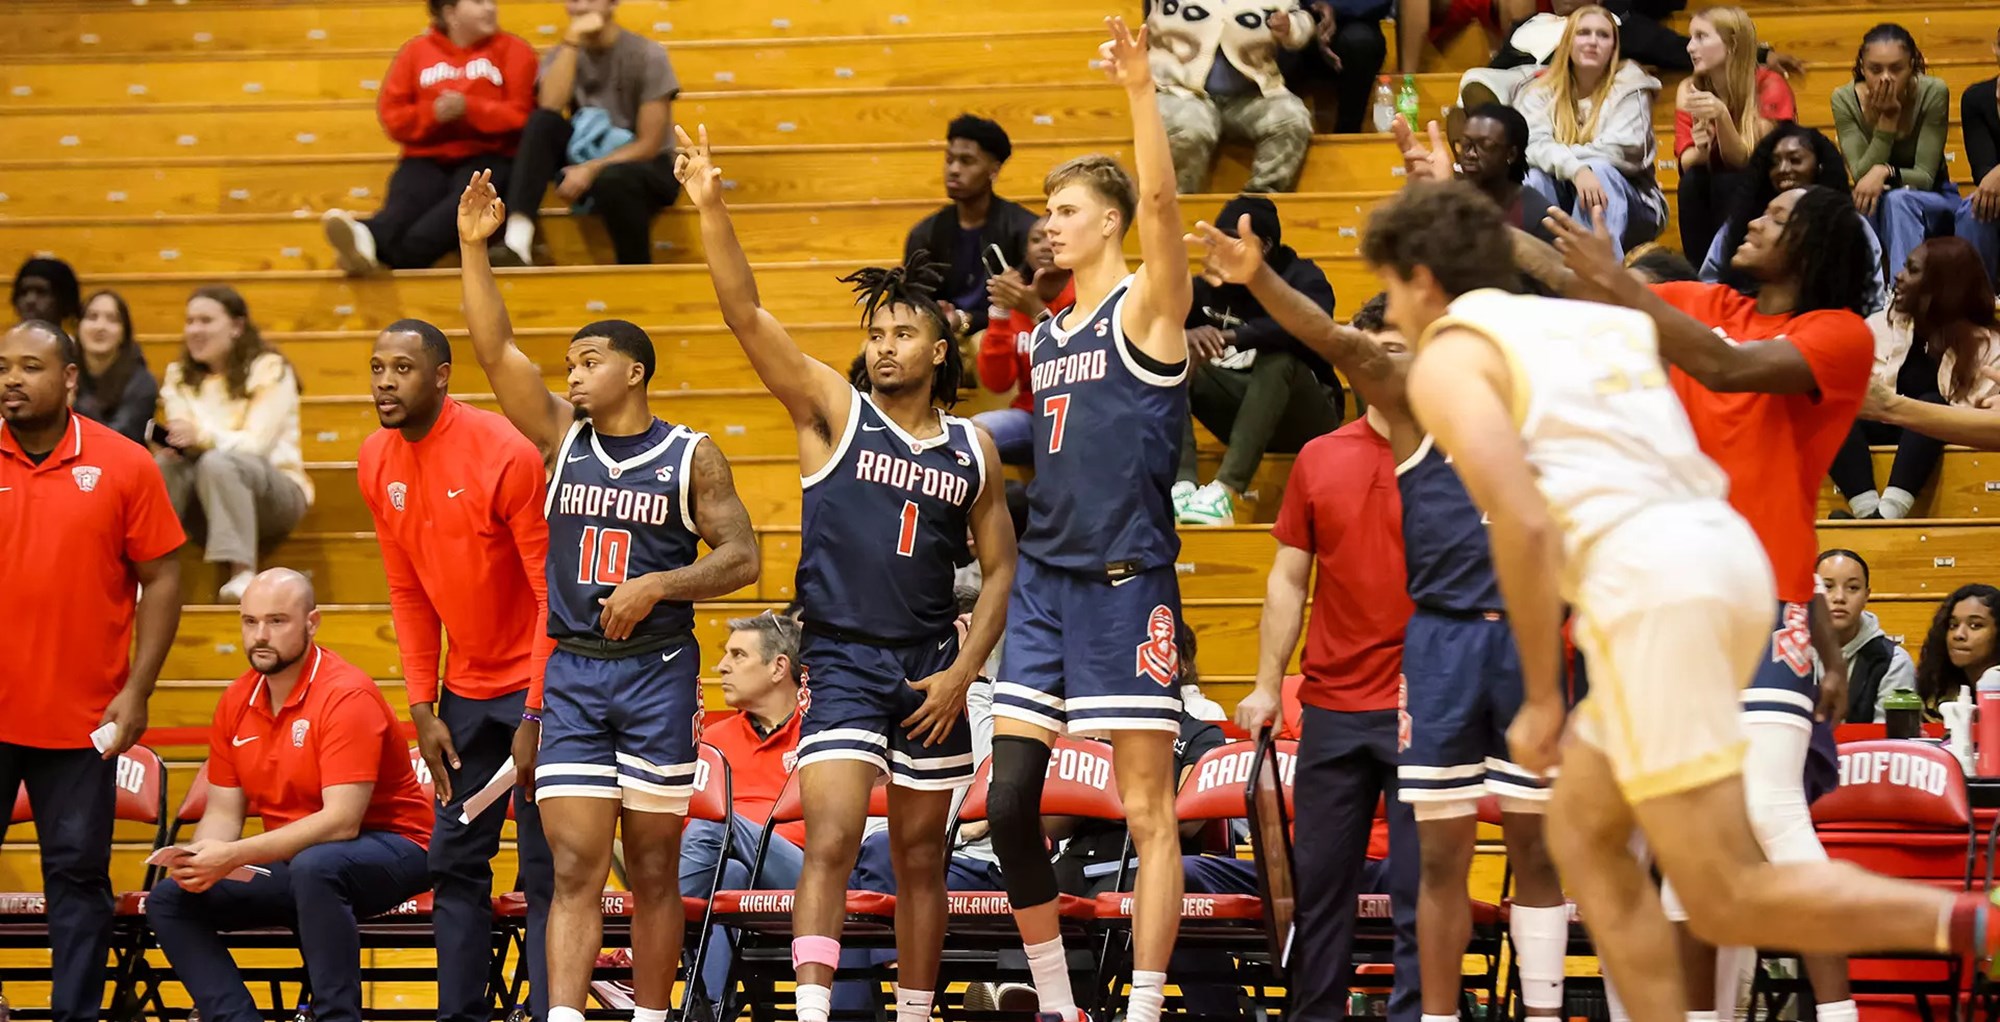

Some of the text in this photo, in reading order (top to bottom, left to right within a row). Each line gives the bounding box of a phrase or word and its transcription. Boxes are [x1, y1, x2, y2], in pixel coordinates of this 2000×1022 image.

[1031, 350, 1107, 394] ADFORD
[1044, 393, 1071, 454] 7
[560, 483, 669, 526] RADFORD
[856, 449, 969, 507] RADFORD
[577, 525, 632, 585] 10
[896, 499, 919, 557] 1
